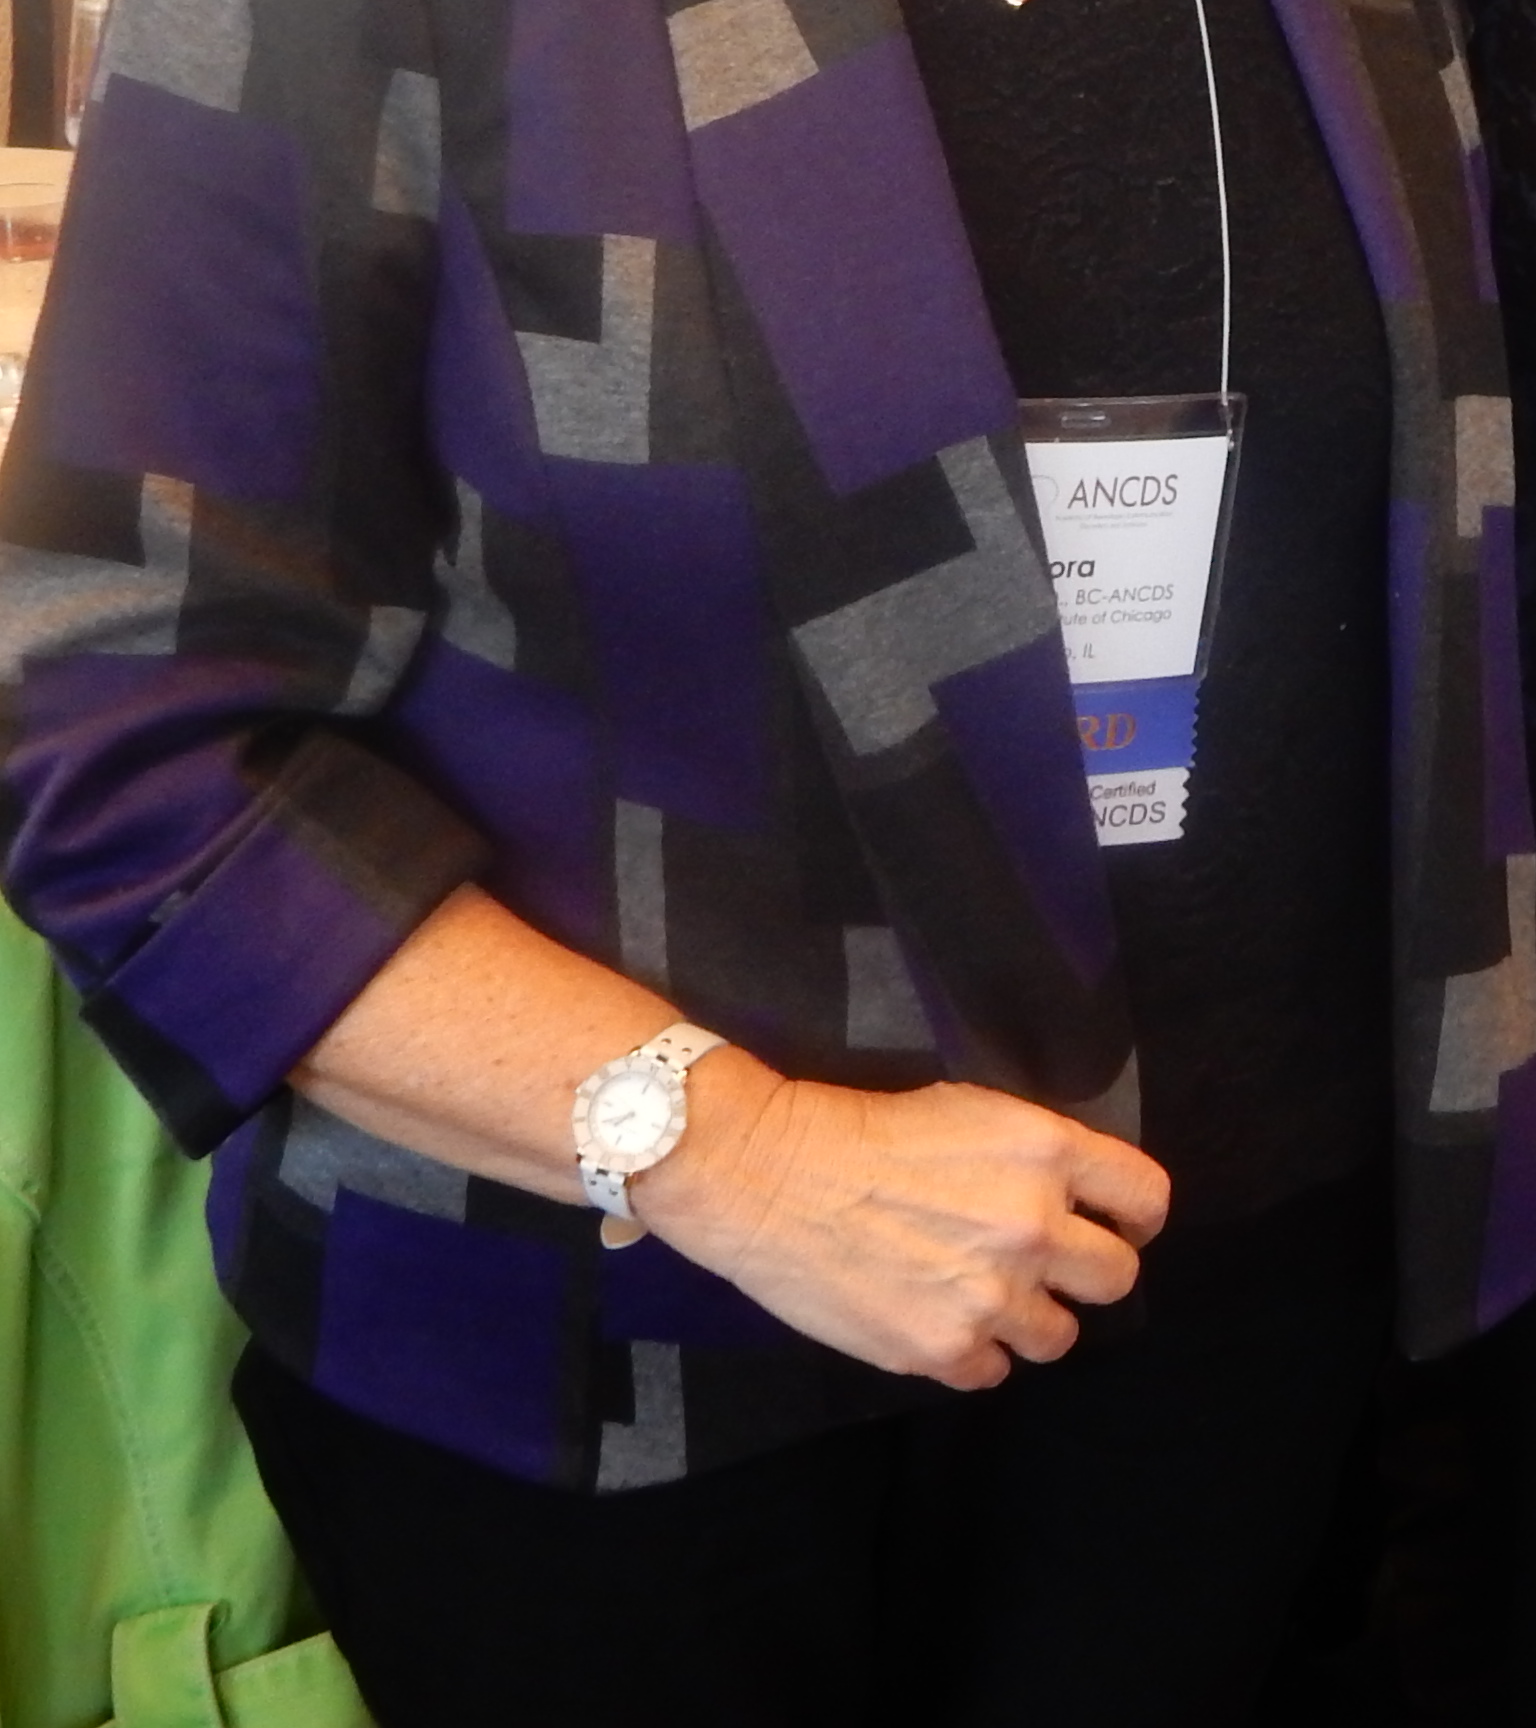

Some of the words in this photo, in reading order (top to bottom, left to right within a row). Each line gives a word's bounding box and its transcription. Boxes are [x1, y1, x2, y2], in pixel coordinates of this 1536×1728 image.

[1066, 473, 1179, 509] ANCDS
[1074, 584, 1175, 606] BC-ANCDS
[1091, 611, 1107, 626] of
[1109, 608, 1173, 625] Chicago
[1082, 643, 1096, 660] IL
[1090, 780, 1157, 801] Certified
